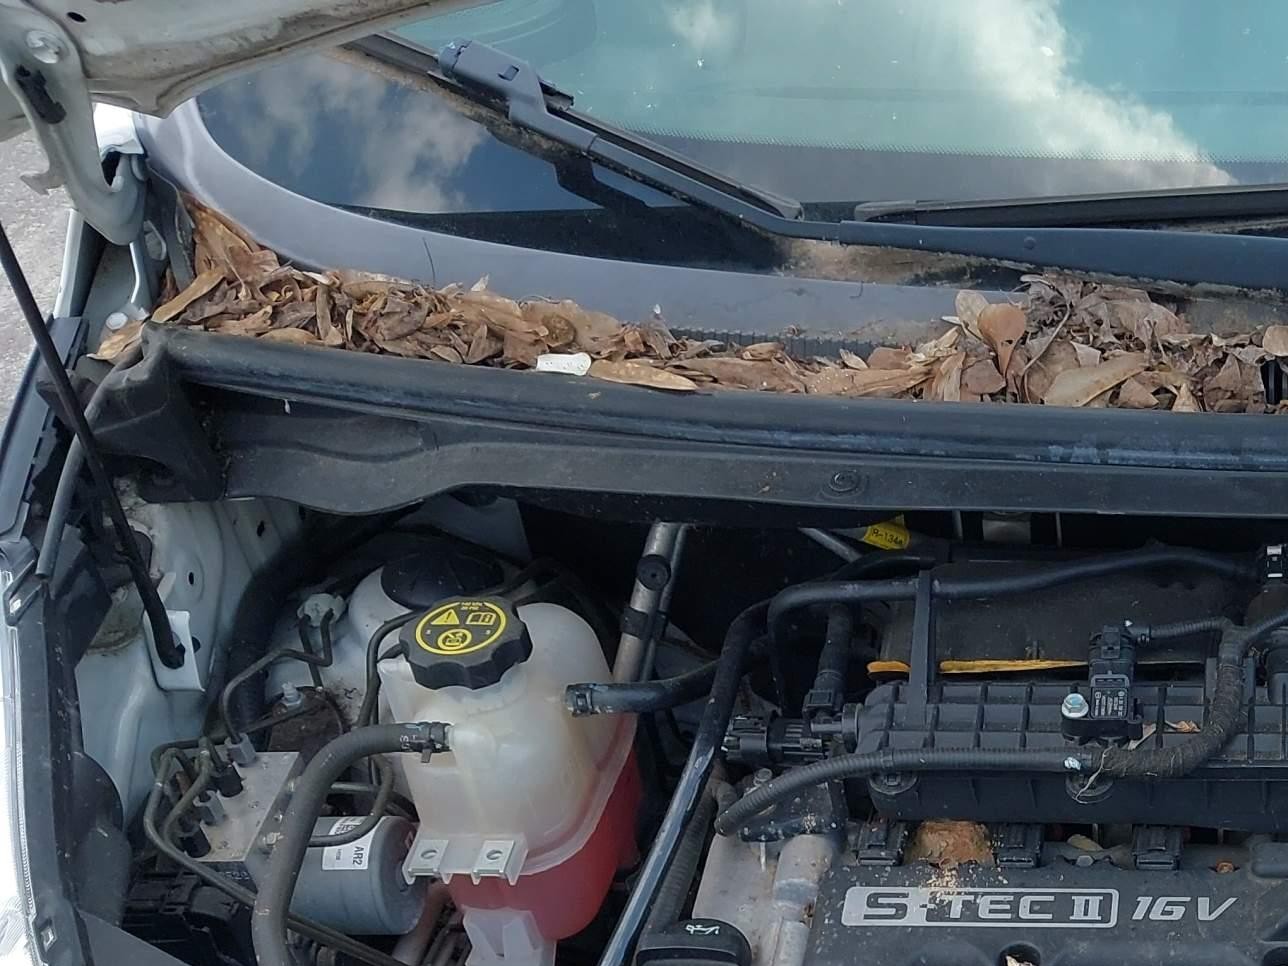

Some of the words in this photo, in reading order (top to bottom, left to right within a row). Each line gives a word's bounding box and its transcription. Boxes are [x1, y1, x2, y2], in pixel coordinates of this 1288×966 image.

[352, 845, 365, 866] AR2
[863, 892, 1056, 920] S-TEC
[1131, 896, 1239, 921] 16V
